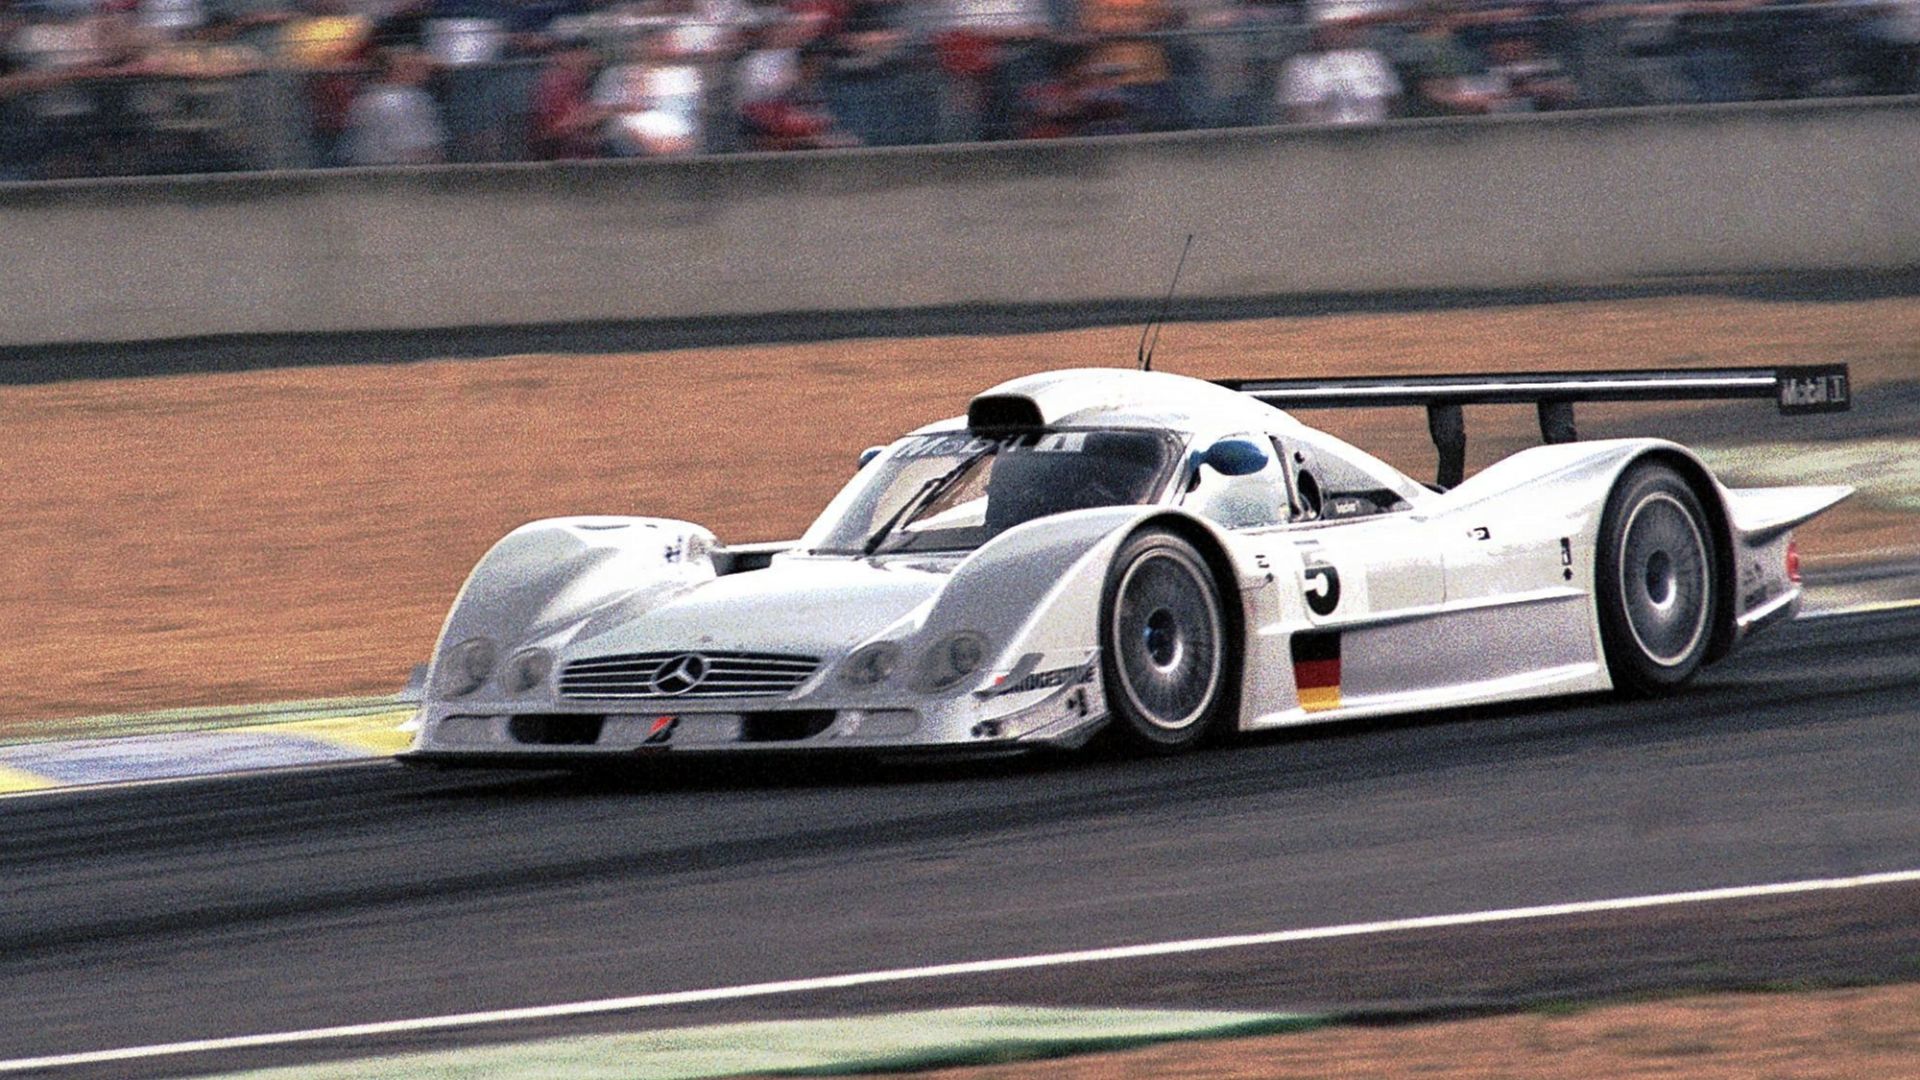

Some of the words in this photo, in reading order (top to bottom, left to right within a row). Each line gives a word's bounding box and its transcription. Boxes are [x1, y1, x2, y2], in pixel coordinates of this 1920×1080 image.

[1781, 377, 1827, 406] Mobil
[895, 435, 1026, 457] Mobil
[1301, 549, 1341, 616] 5
